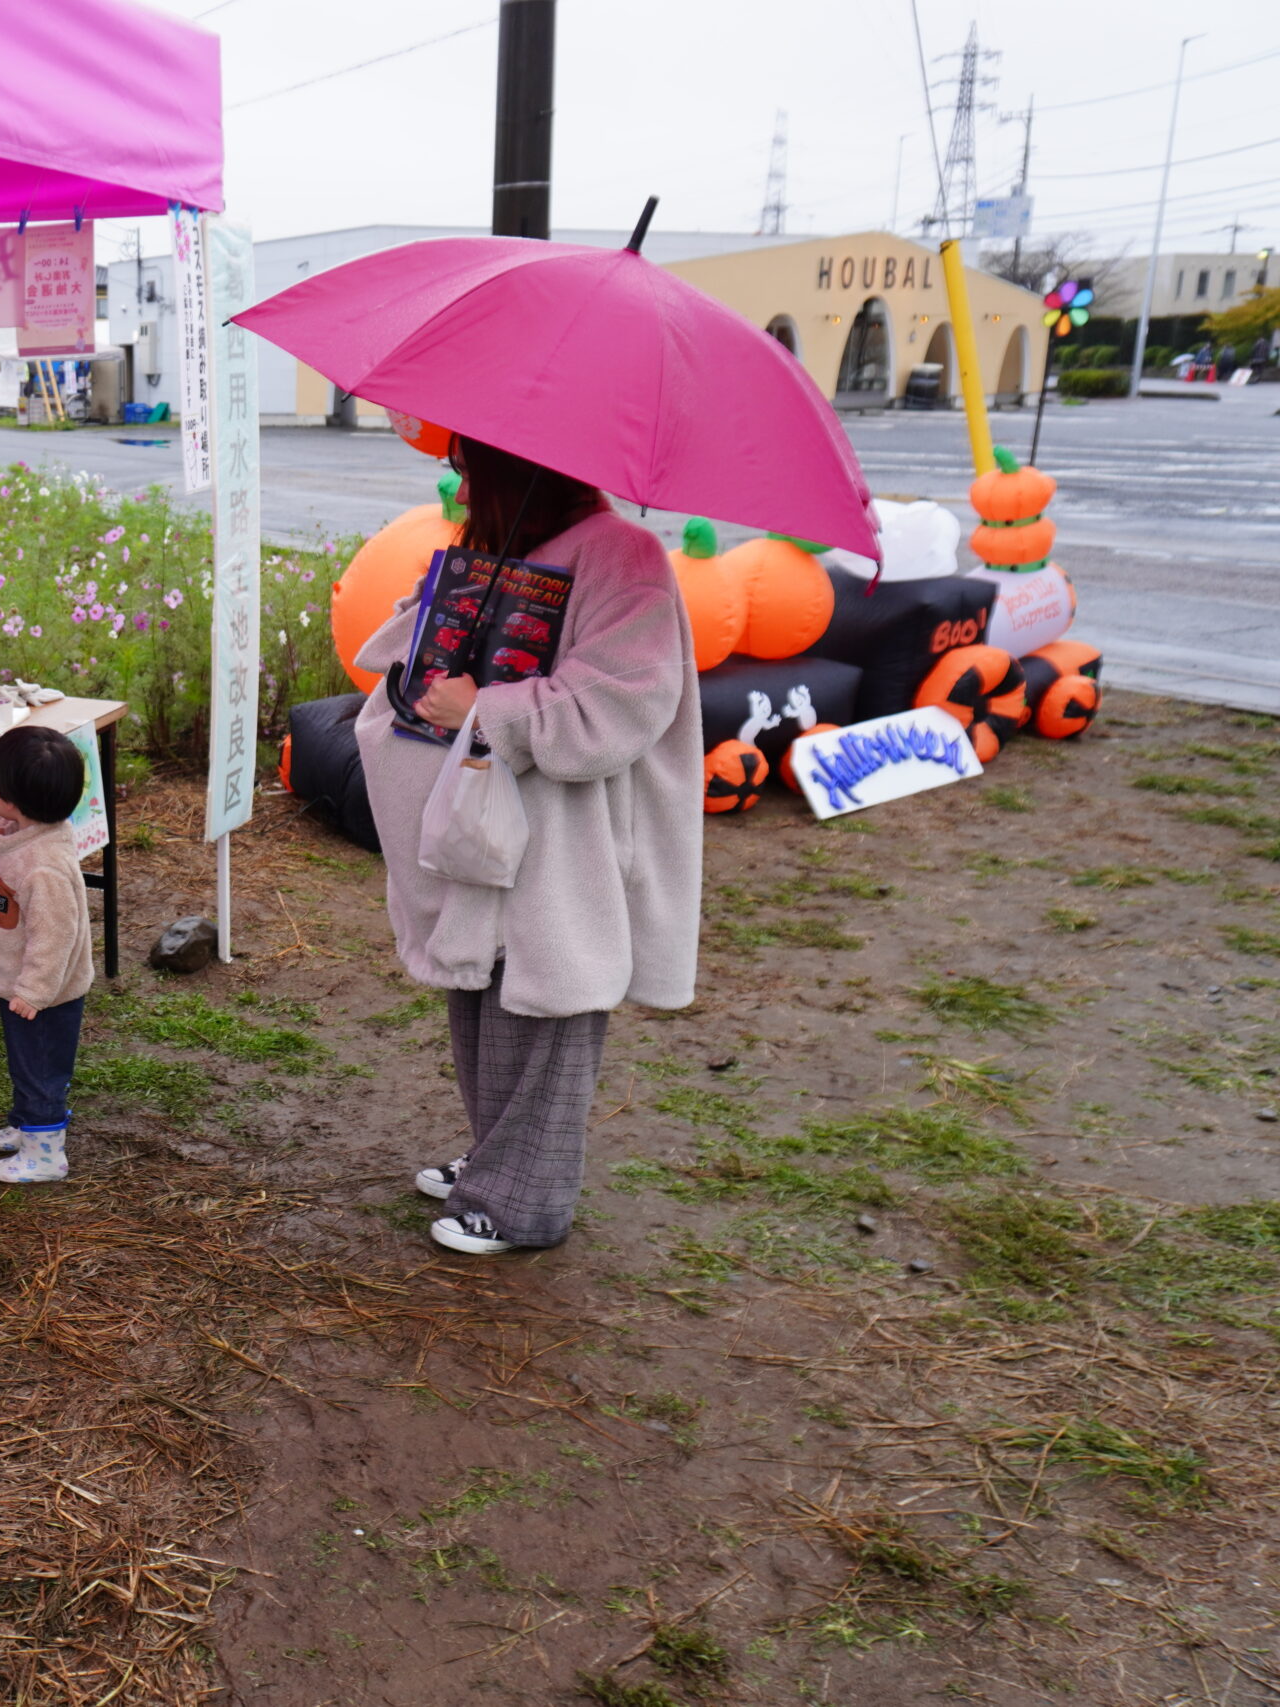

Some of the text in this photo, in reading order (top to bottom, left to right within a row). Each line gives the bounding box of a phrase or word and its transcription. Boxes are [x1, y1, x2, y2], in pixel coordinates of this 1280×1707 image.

[818, 256, 933, 290] HOUBAL
[193, 226, 210, 480] コスモス摘み取り場所
[500, 581, 565, 607] BUREAU
[811, 721, 968, 810] Halloween
